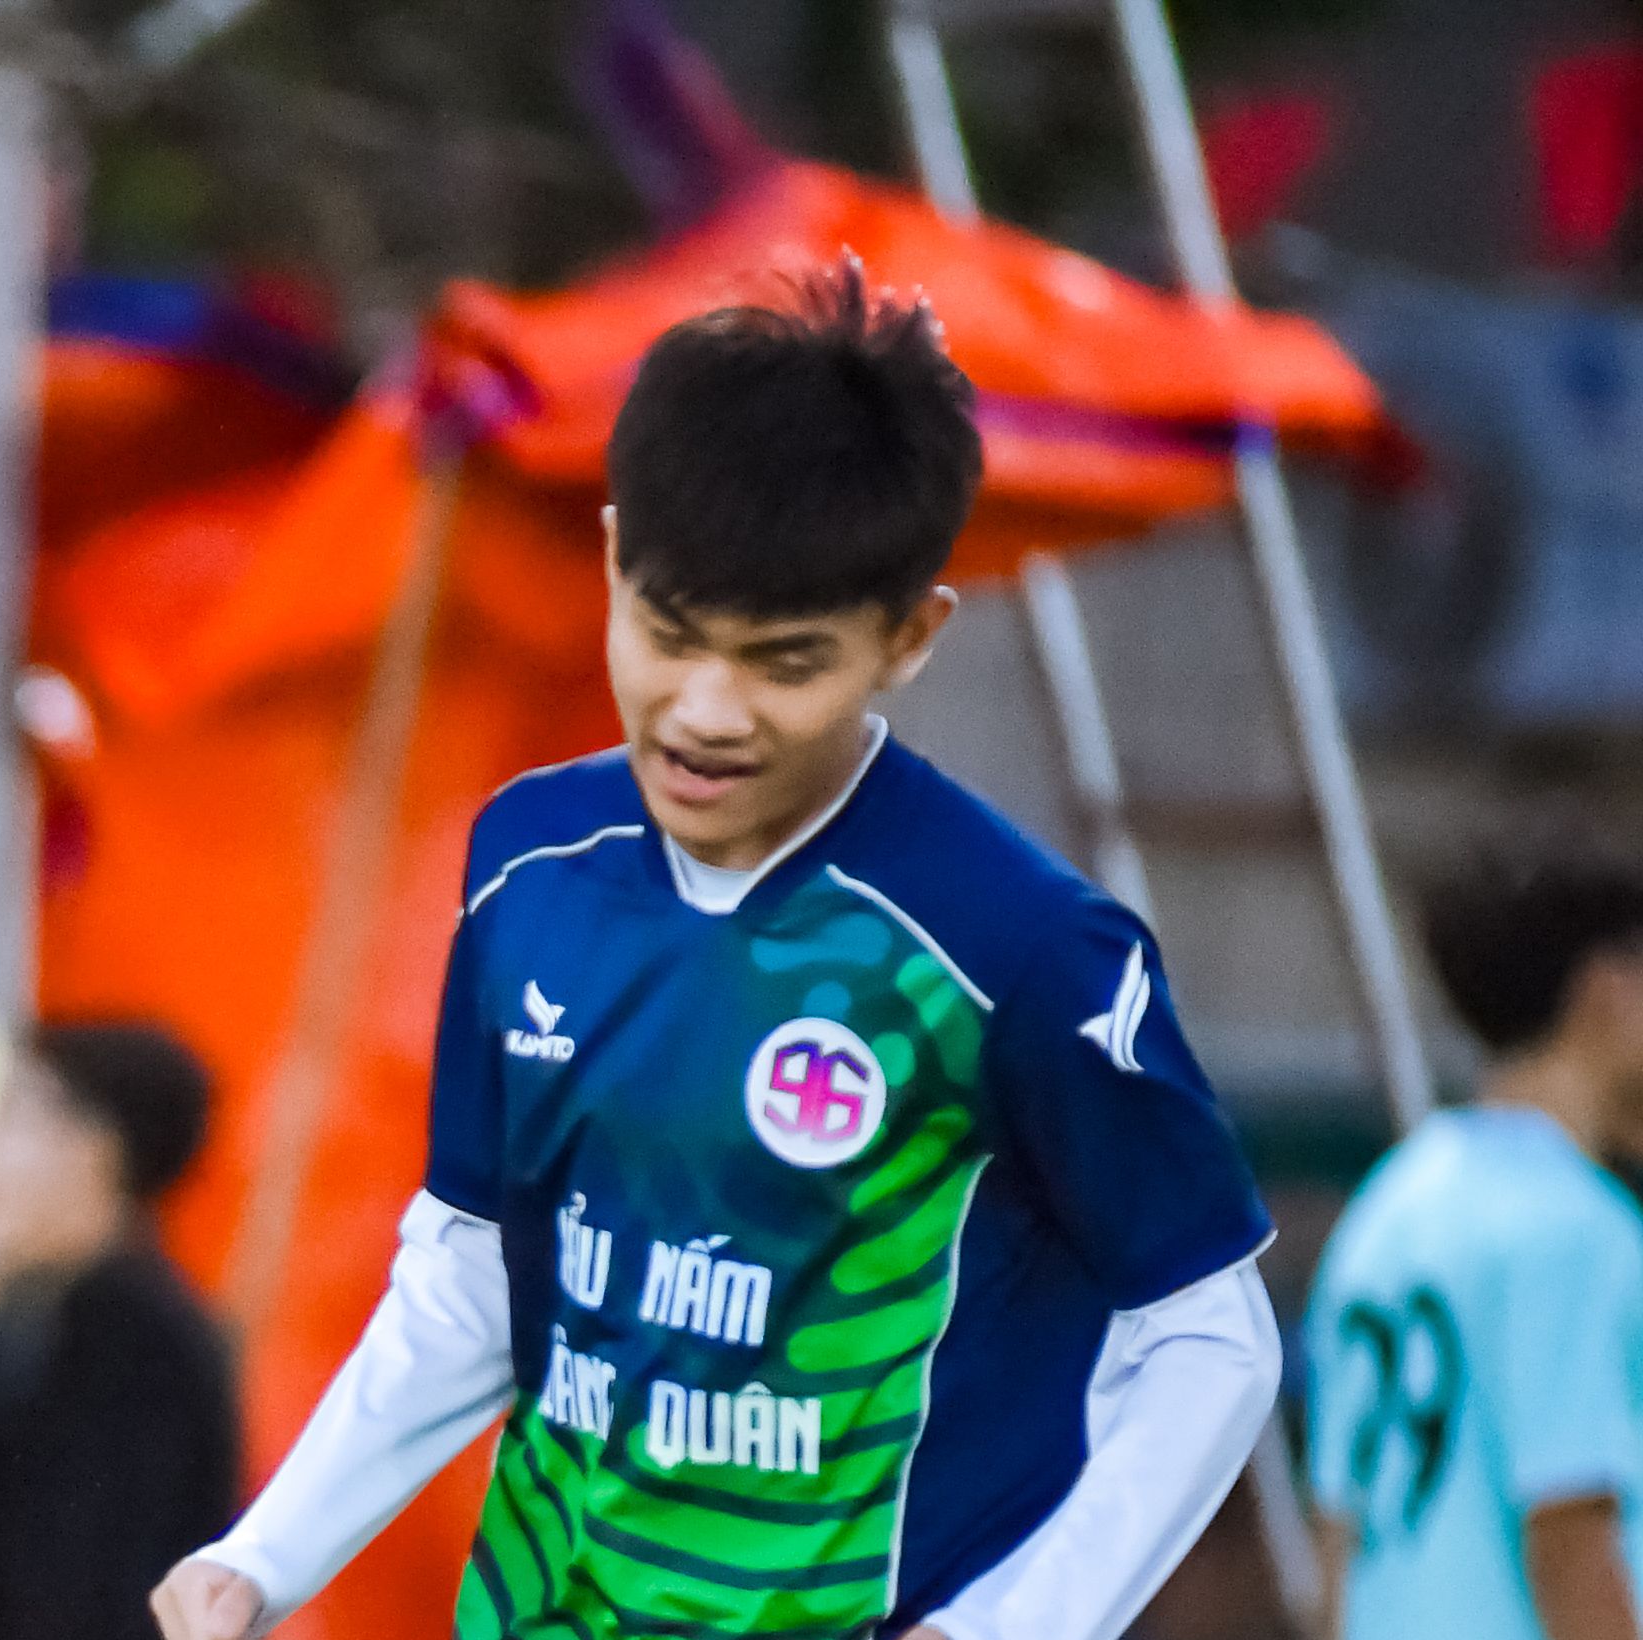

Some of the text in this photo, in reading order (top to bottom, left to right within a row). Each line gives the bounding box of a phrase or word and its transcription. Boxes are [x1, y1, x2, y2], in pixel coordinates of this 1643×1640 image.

[763, 1040, 870, 1140] 96
[638, 1233, 773, 1347] NẤM
[645, 1379, 822, 1475] QUÂN
